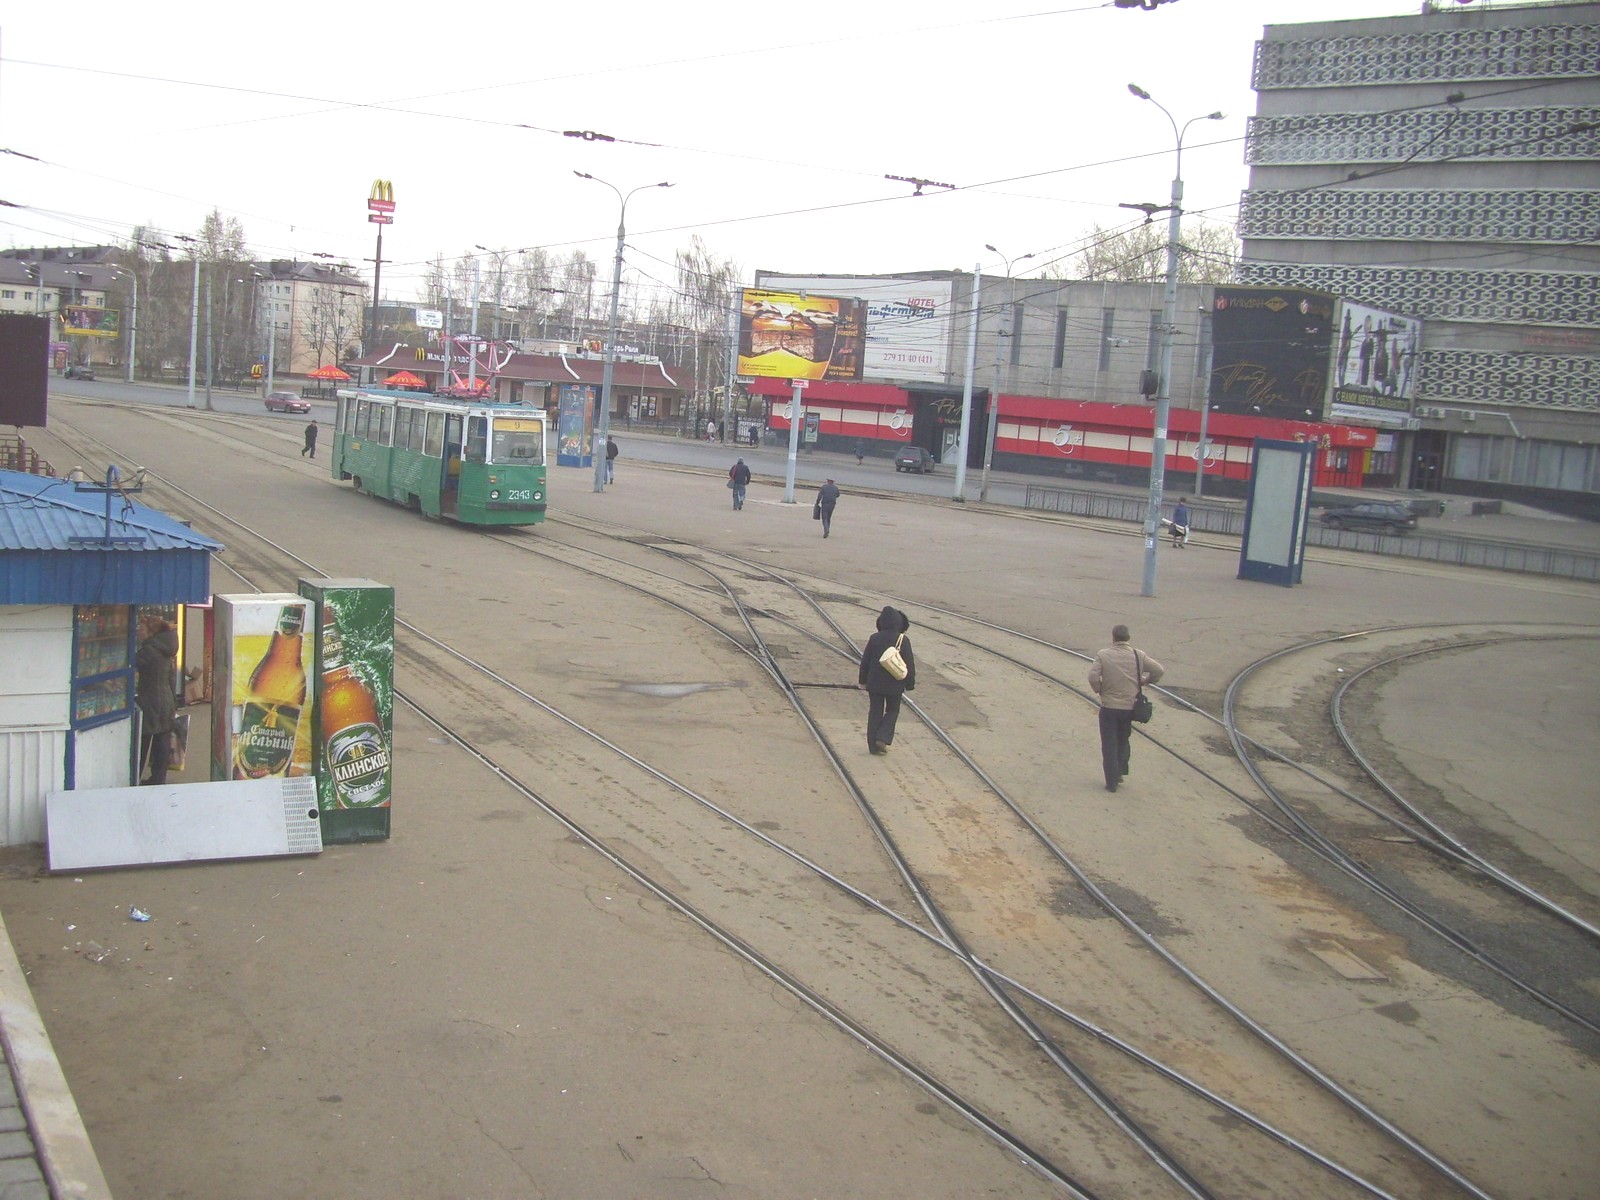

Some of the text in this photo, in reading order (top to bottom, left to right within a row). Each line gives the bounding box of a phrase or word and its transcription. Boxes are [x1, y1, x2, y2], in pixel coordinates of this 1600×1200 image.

[908, 297, 936, 307] HOTEL
[882, 353, 896, 361] 279
[908, 354, 917, 362] 40
[514, 421, 520, 430] 9
[509, 490, 530, 500] 2343
